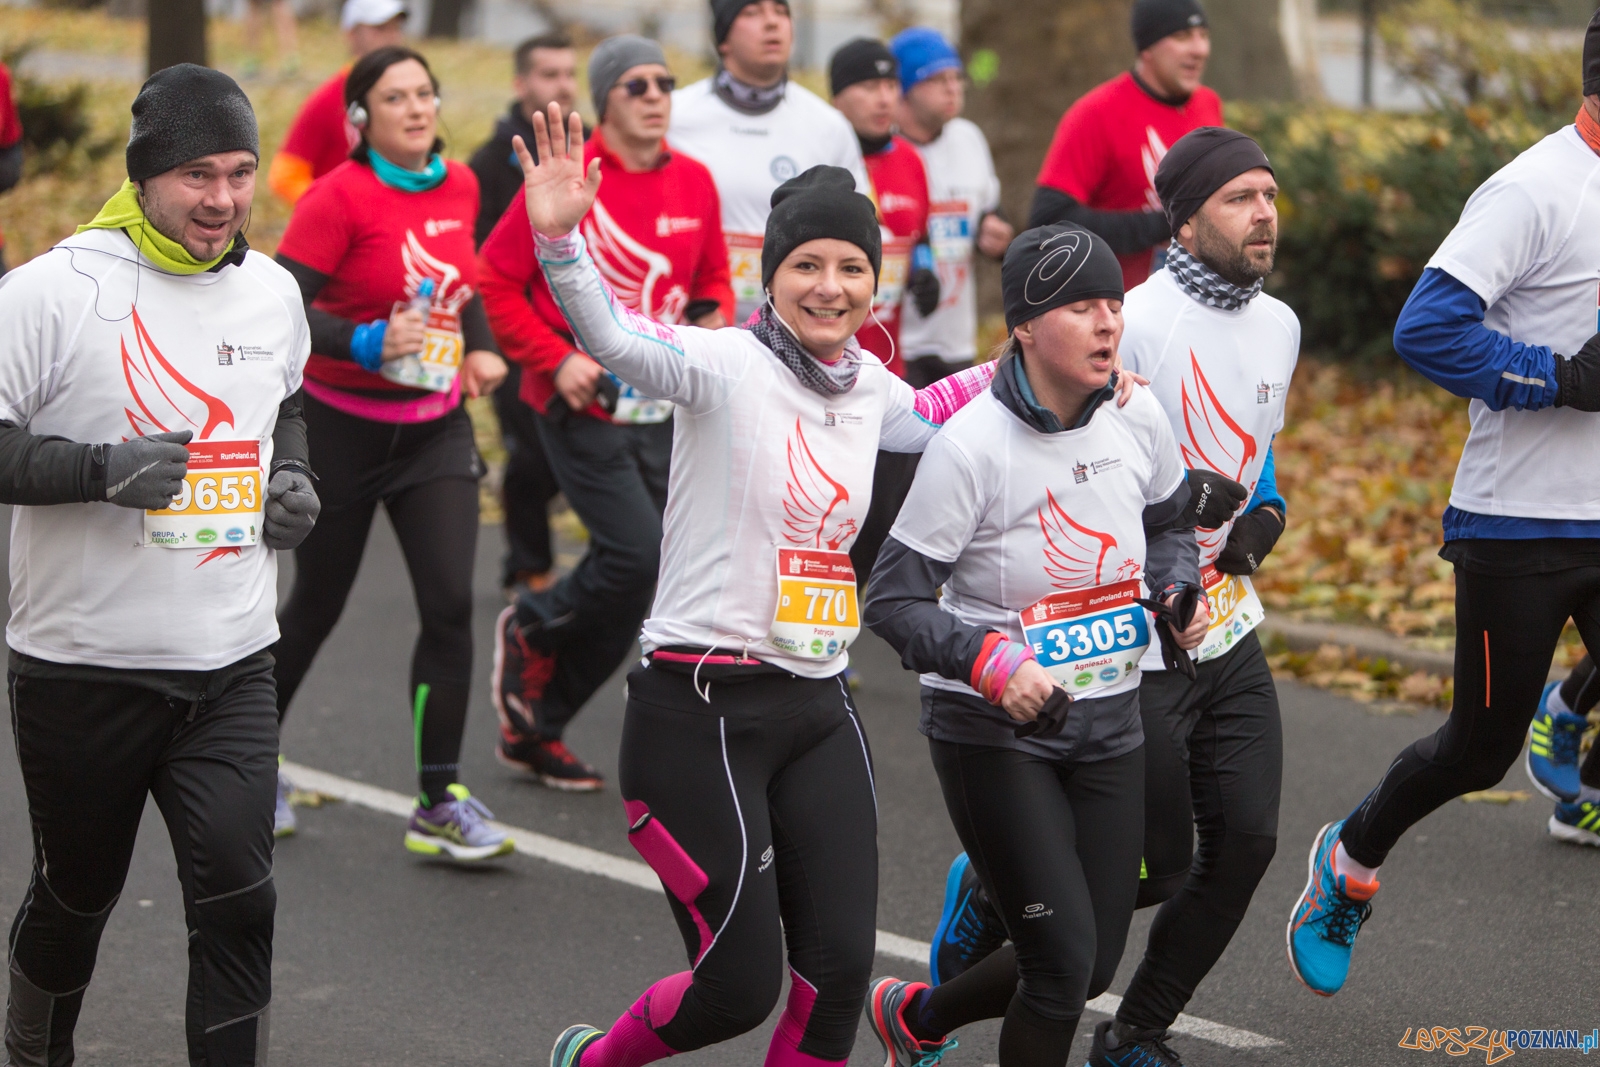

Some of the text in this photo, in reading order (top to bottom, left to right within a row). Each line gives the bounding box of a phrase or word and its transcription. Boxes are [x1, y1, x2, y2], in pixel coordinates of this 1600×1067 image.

[238, 345, 246, 361] 1
[220, 452, 257, 461] RunPoland.org
[1090, 462, 1098, 475] 1
[168, 475, 256, 511] 9653
[152, 537, 180, 545] LUXMED
[782, 586, 847, 623] D 770
[1089, 590, 1134, 606] RunPoland.org
[1049, 603, 1056, 615] 1
[813, 627, 835, 637] Patrycja
[1033, 613, 1137, 661] E 3305
[1074, 657, 1113, 671] Agnieszka
